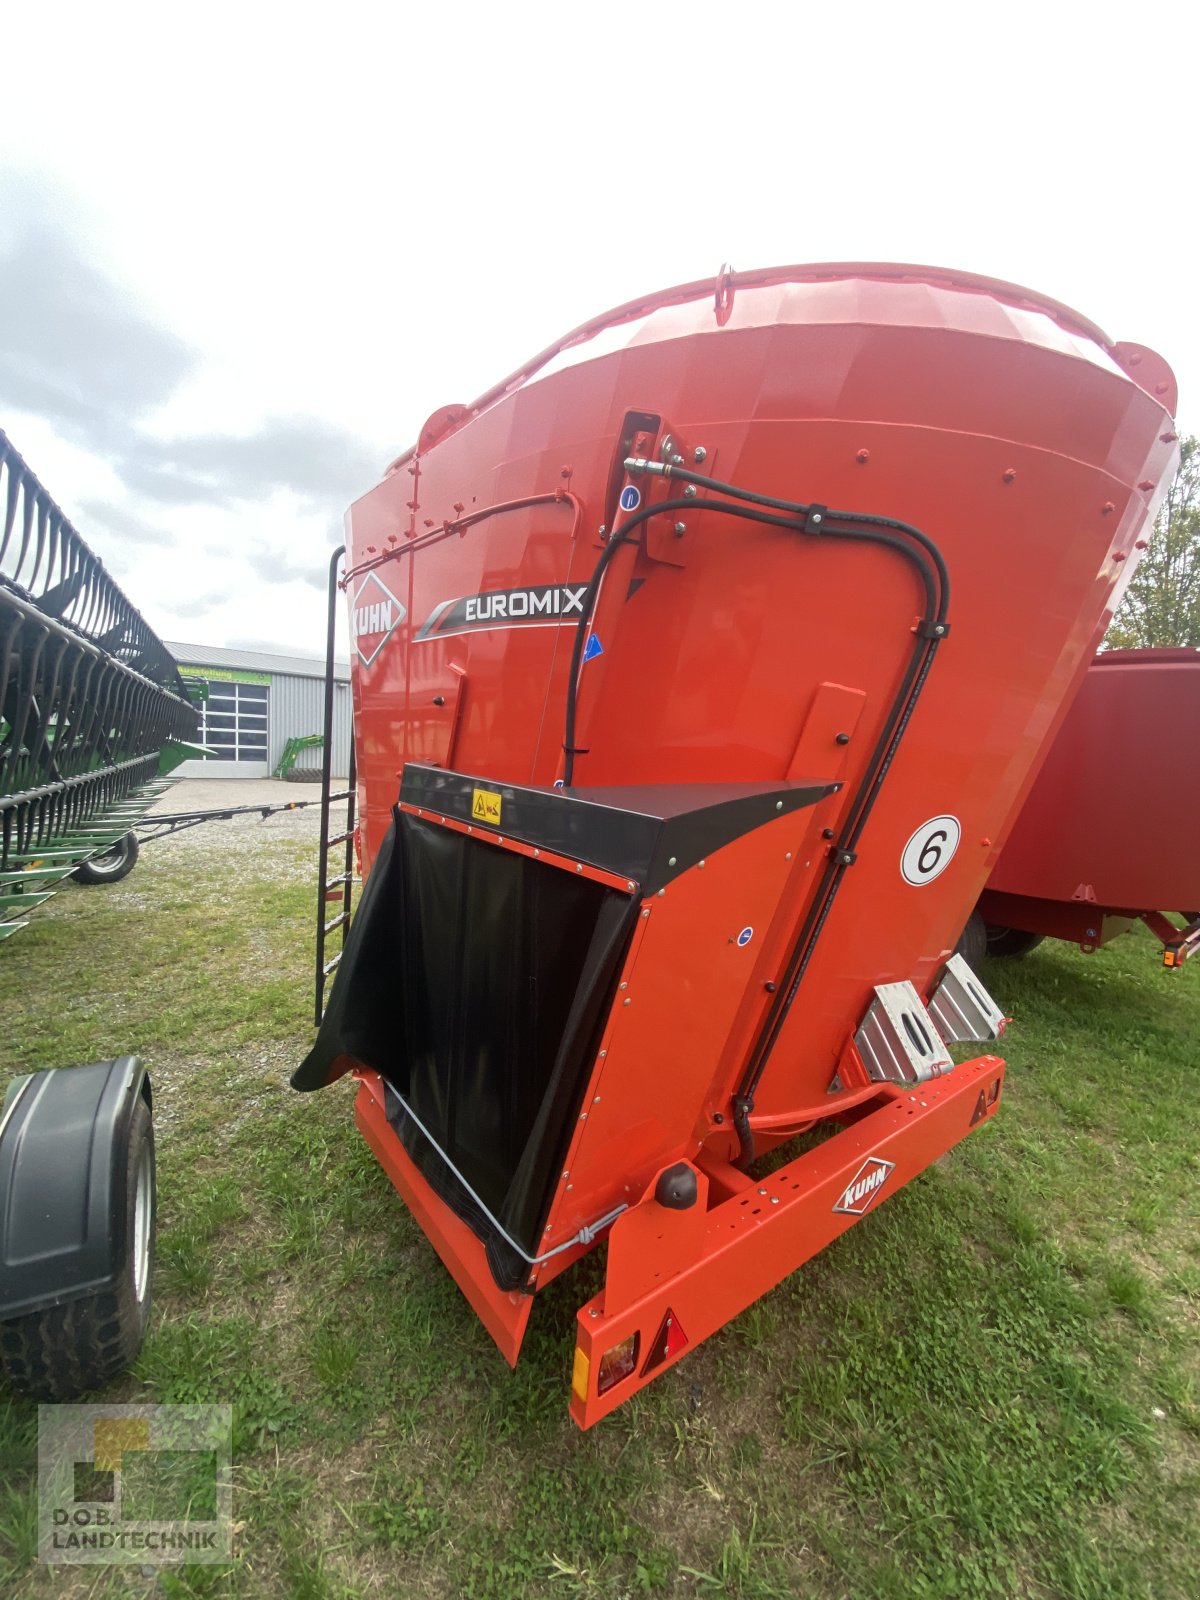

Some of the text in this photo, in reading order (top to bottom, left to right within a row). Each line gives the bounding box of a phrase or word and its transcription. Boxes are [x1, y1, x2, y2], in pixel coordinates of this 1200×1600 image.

[352, 600, 392, 636] KUHN
[465, 587, 588, 621] EUROMIX
[917, 829, 948, 874] 6
[843, 1164, 887, 1209] KUHN
